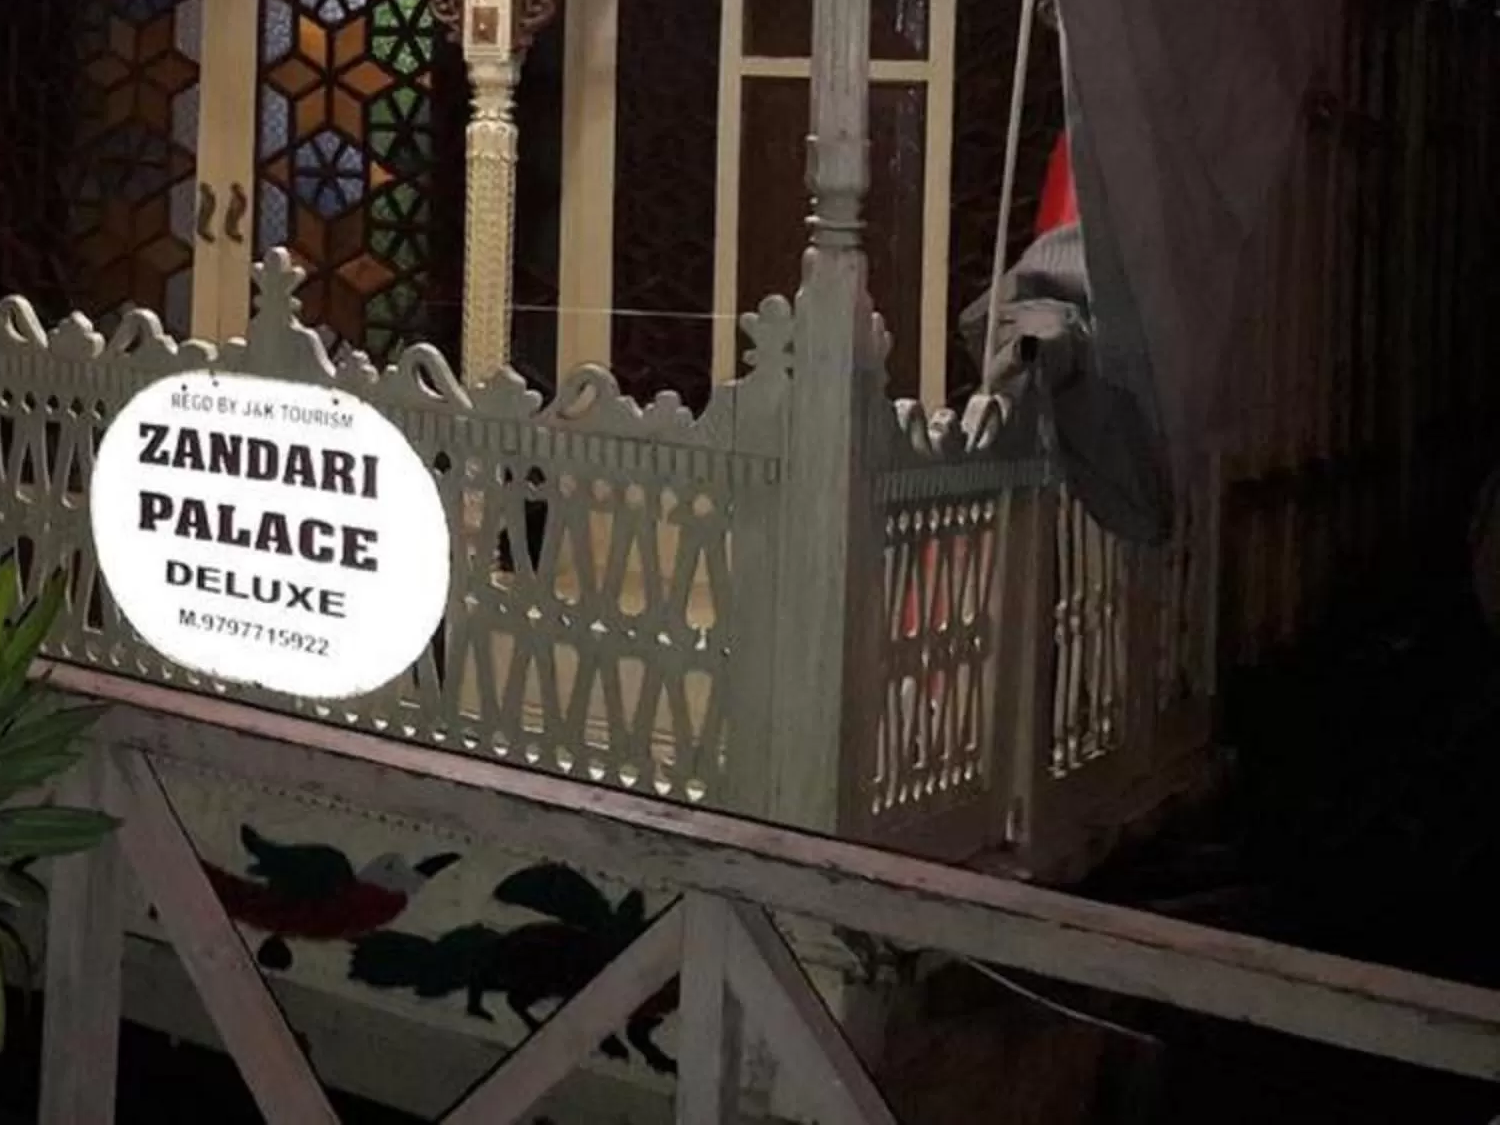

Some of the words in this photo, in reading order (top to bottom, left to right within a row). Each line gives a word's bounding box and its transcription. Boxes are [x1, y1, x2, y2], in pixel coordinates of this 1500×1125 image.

[217, 396, 237, 414] BY
[280, 404, 353, 428] TOURISM
[139, 423, 378, 499] ZANDARI
[139, 491, 378, 572] PALACE
[166, 560, 346, 619] DELUXE
[179, 608, 329, 656] M.9797715922
